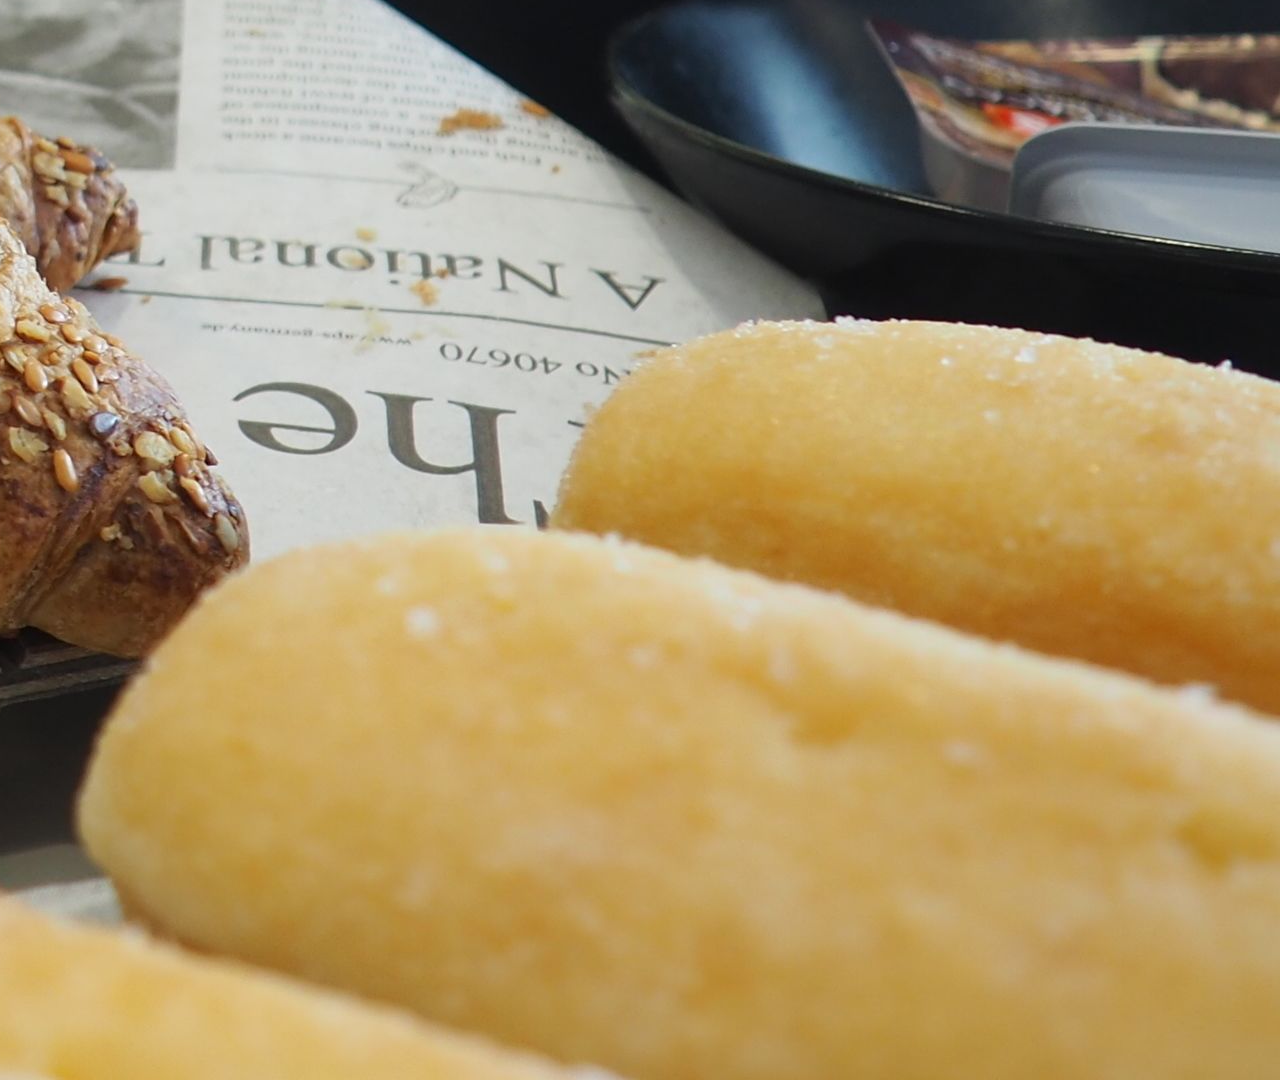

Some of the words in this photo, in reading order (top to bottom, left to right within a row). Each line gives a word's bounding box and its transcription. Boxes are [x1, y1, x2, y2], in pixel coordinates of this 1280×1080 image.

[196, 234, 568, 299] National
[590, 268, 665, 311] A
[438, 342, 563, 376] 40670
[231, 380, 586, 531] he
